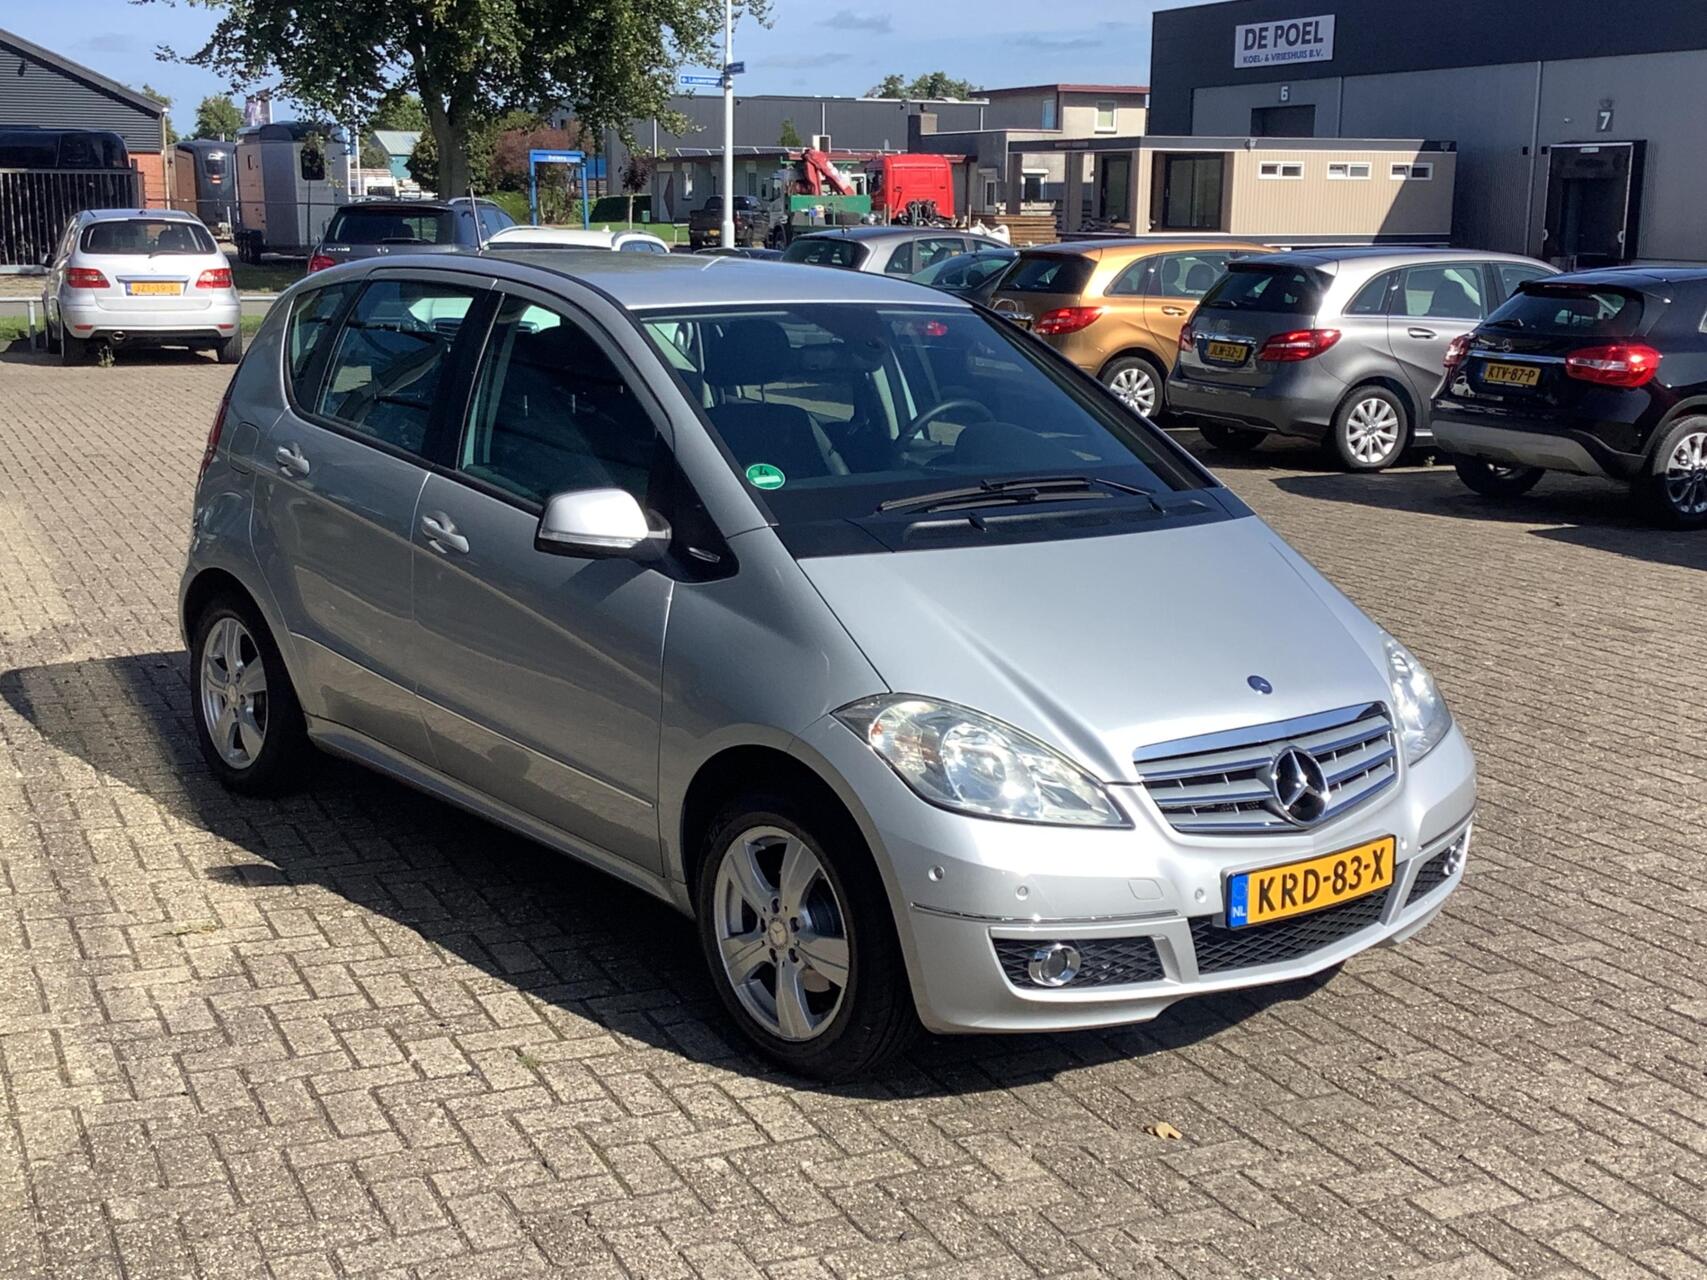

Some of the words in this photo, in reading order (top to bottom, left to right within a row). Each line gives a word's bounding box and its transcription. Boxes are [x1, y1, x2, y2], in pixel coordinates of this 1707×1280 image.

[1243, 26, 1270, 51] DE
[1273, 20, 1324, 49] POEL
[1264, 53, 1270, 62] &
[1270, 49, 1308, 61] VRIESHUIS
[1308, 48, 1324, 58] B.V.
[1280, 85, 1289, 101] 6
[1600, 111, 1611, 130] 7
[1486, 365, 1536, 383] KTV-87-P
[1258, 847, 1386, 915] KRD-83-X
[1232, 906, 1247, 918] NL
